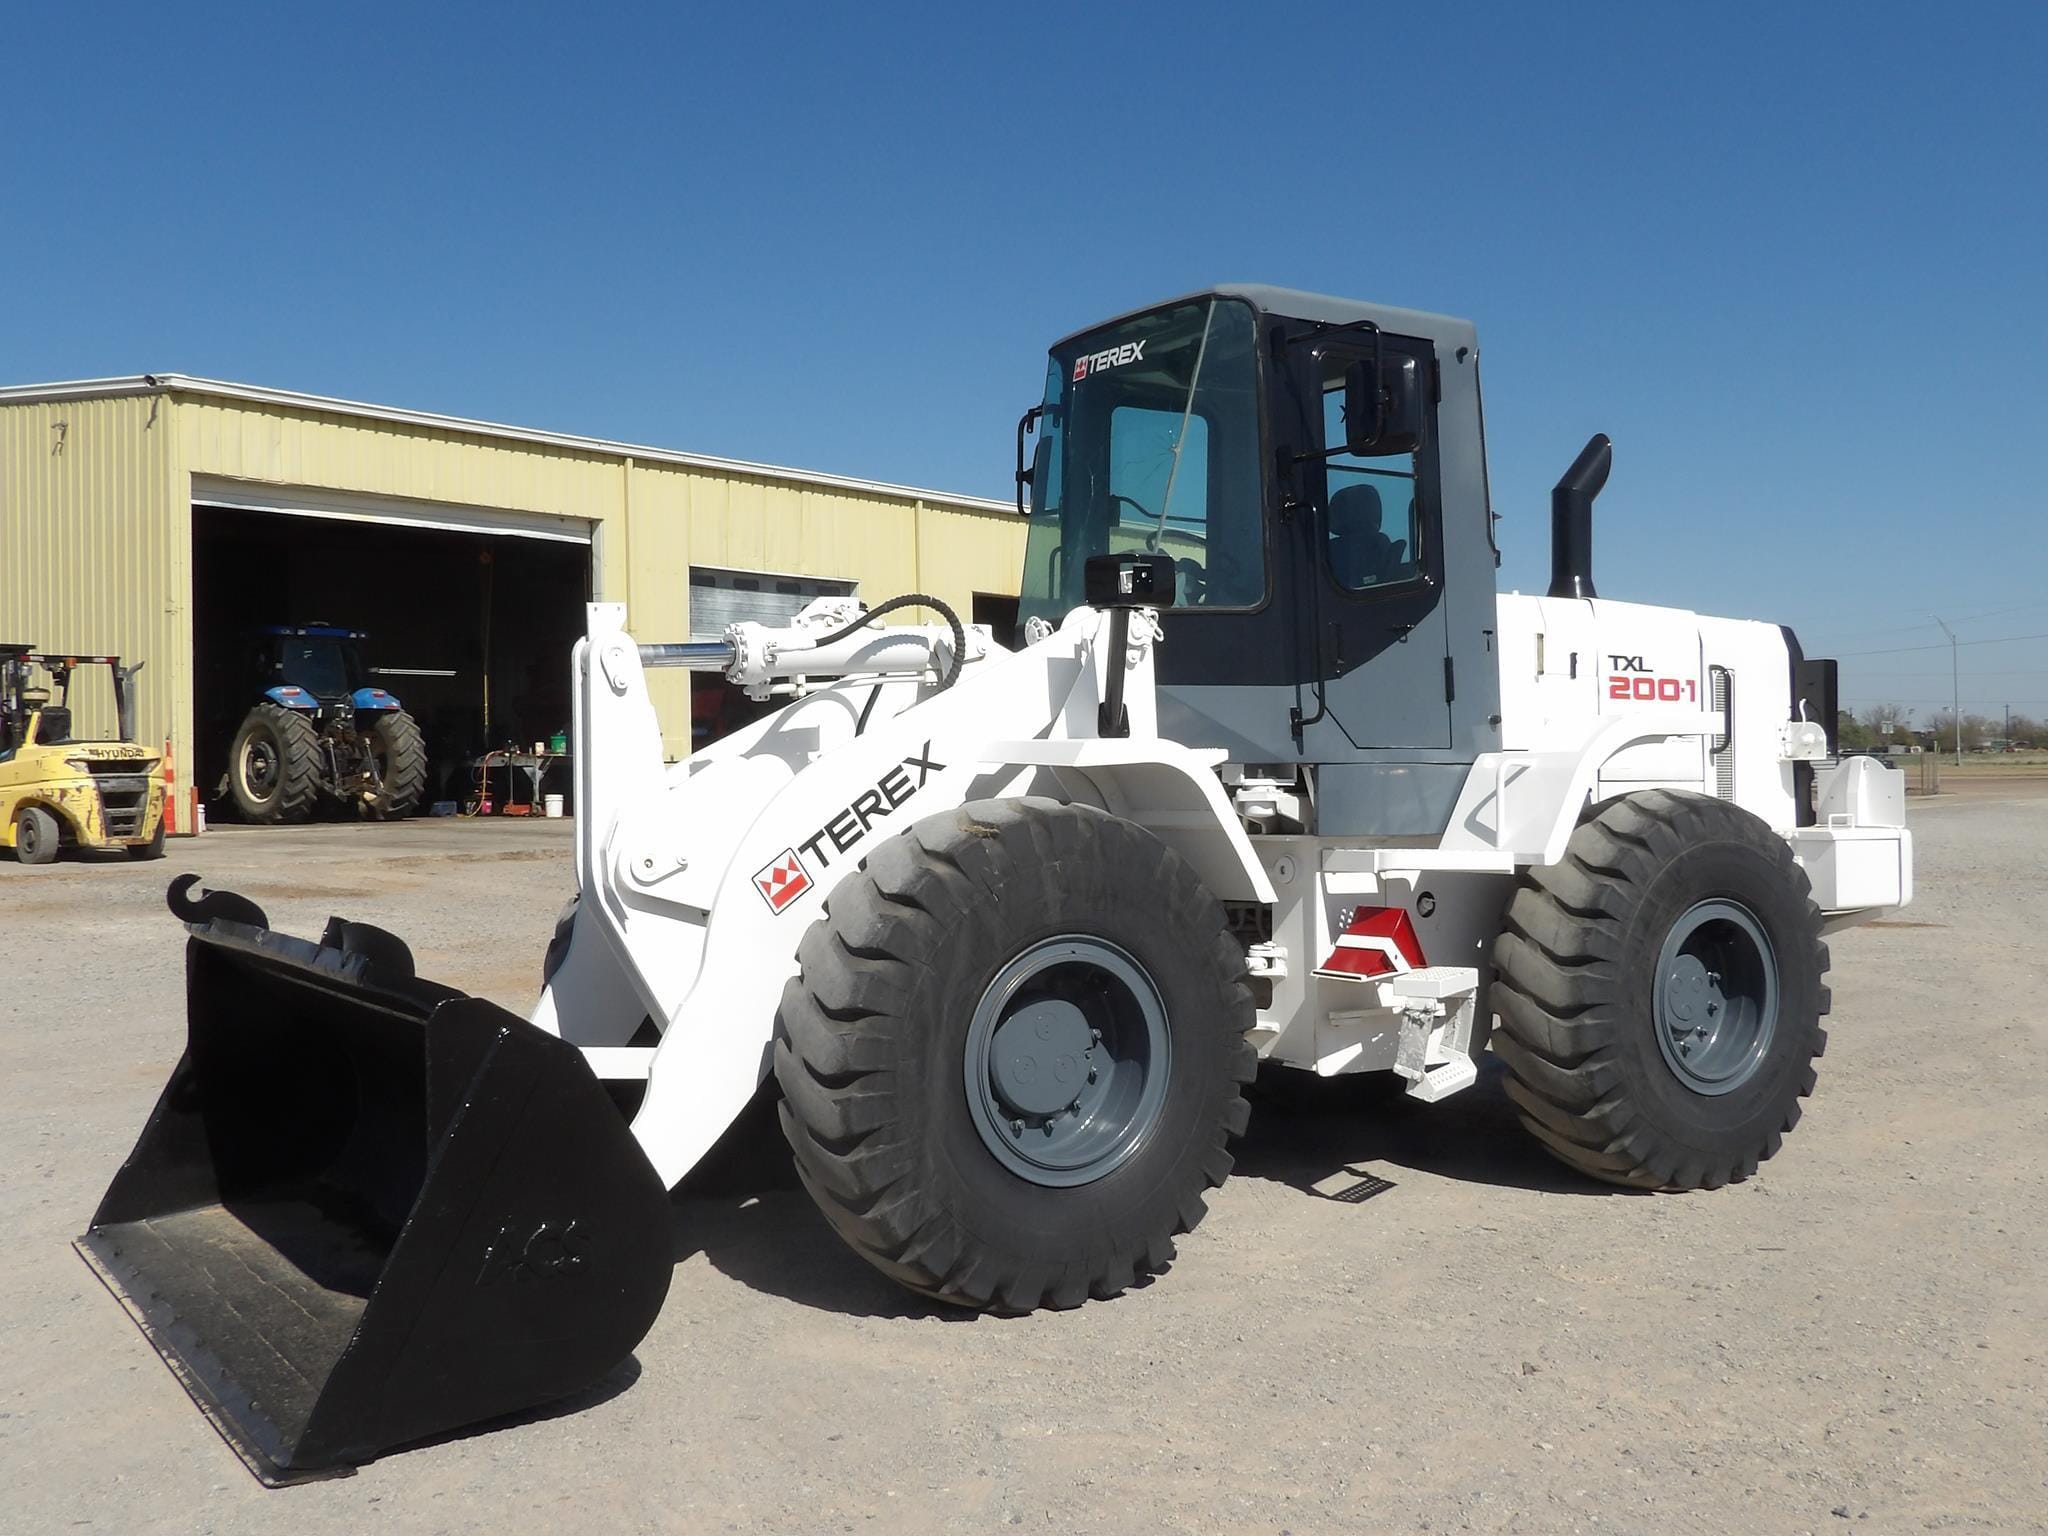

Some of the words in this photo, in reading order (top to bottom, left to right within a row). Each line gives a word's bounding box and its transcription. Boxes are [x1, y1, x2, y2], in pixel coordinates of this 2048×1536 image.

[1089, 339, 1147, 374] TEREX
[1608, 654, 1653, 672] TXL
[797, 739, 947, 868] TEREX
